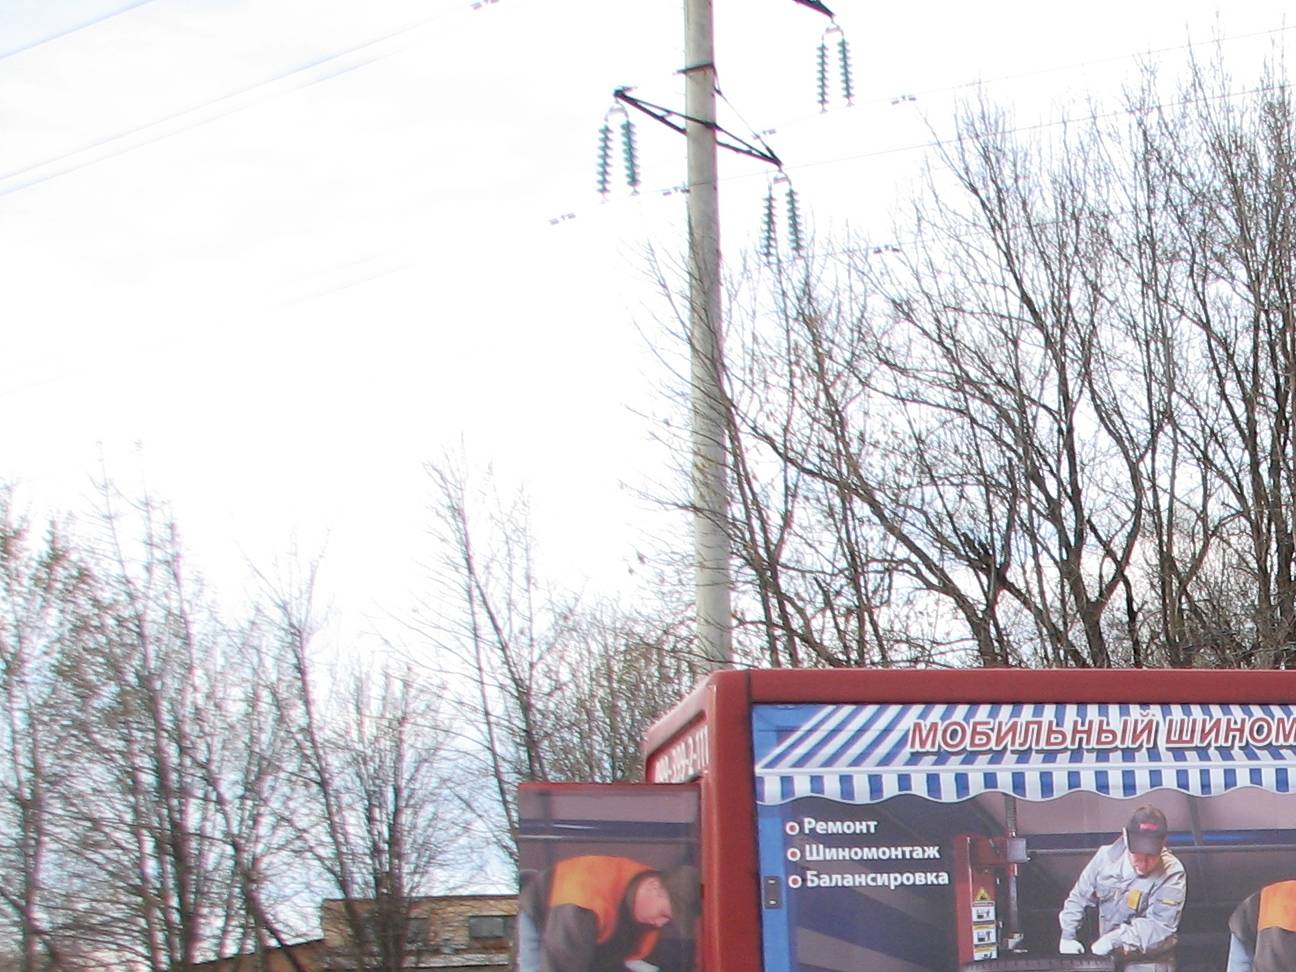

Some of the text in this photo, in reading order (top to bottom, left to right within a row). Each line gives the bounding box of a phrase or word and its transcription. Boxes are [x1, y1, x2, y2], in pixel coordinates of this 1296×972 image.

[909, 709, 1158, 753] МОБИЛЬНЫЙ
[804, 817, 878, 834] Ремонт
[805, 844, 941, 861] Шиномонтаж
[806, 870, 950, 889] Балансировка
